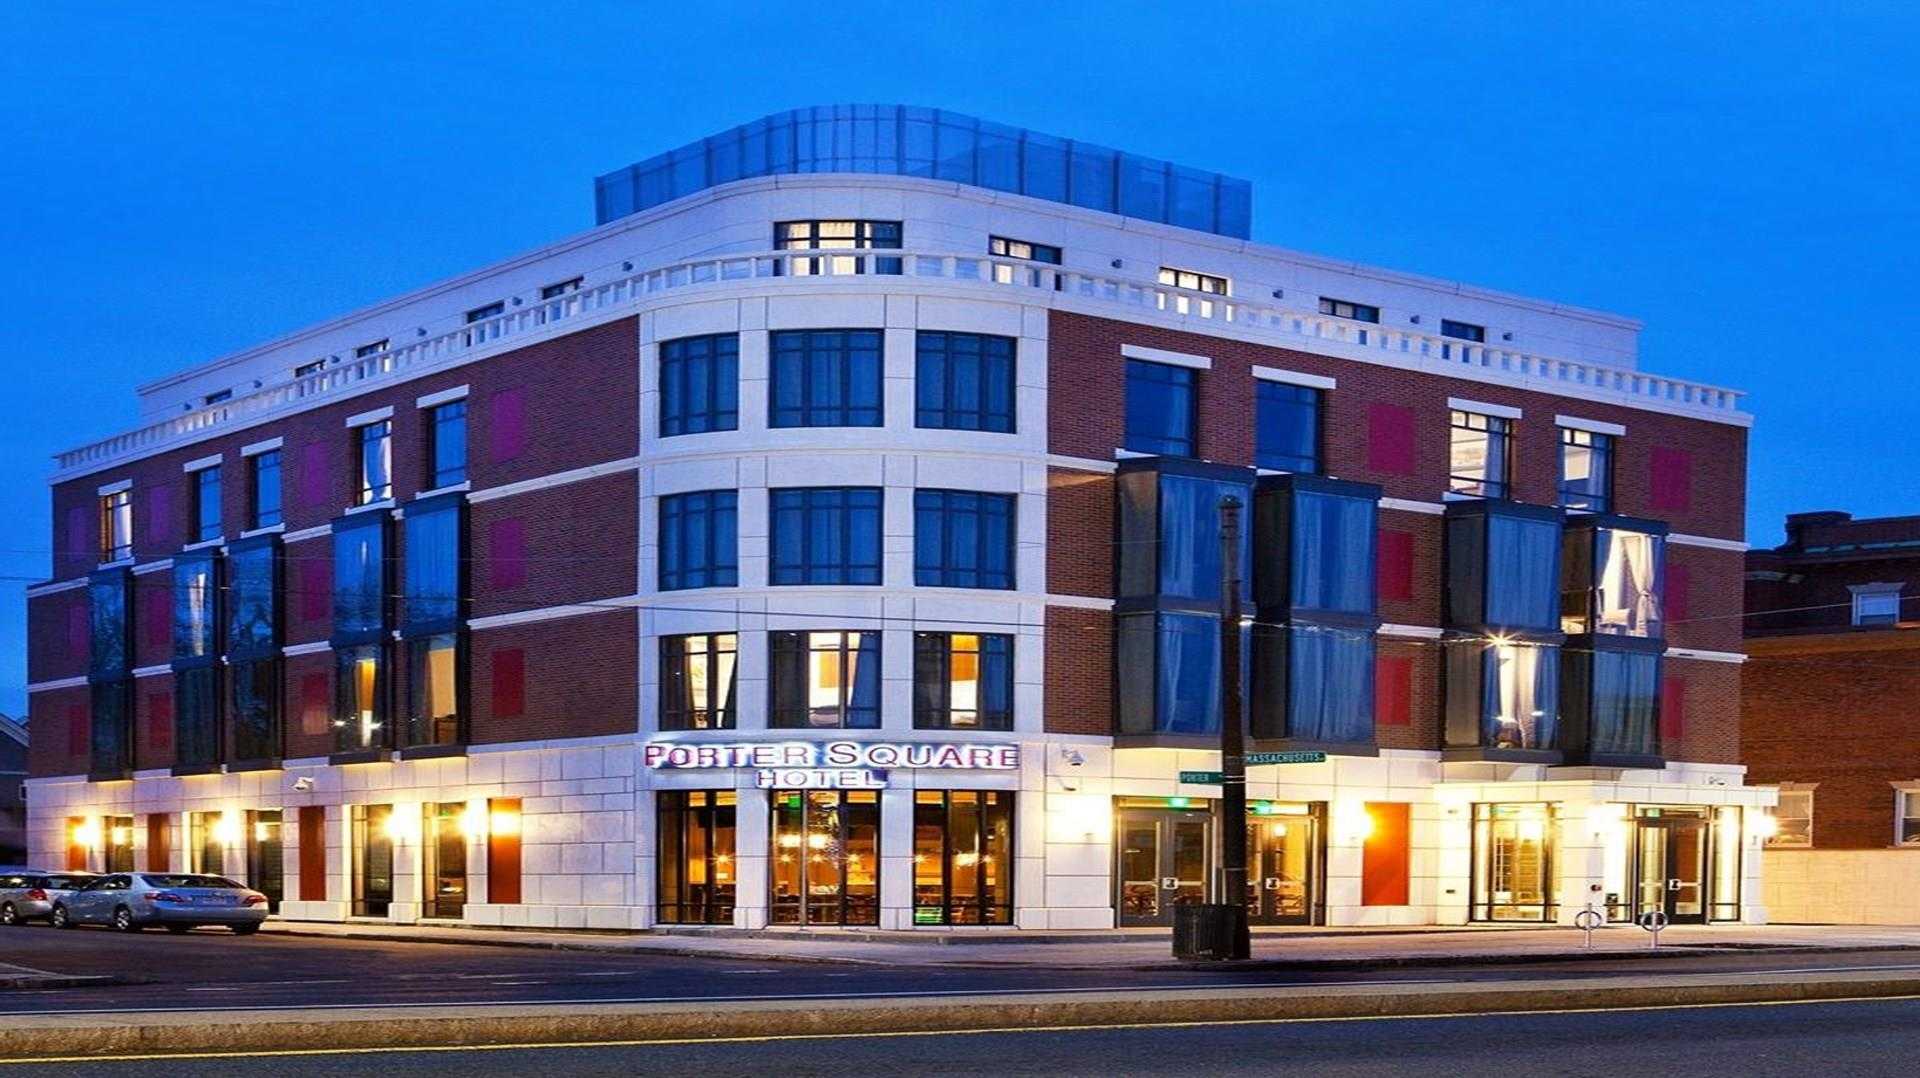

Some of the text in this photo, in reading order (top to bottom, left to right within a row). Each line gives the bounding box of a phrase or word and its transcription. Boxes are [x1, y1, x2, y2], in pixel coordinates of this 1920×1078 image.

[644, 743, 1019, 767] PORTER SQUARE
[757, 771, 884, 787] HOTEL
